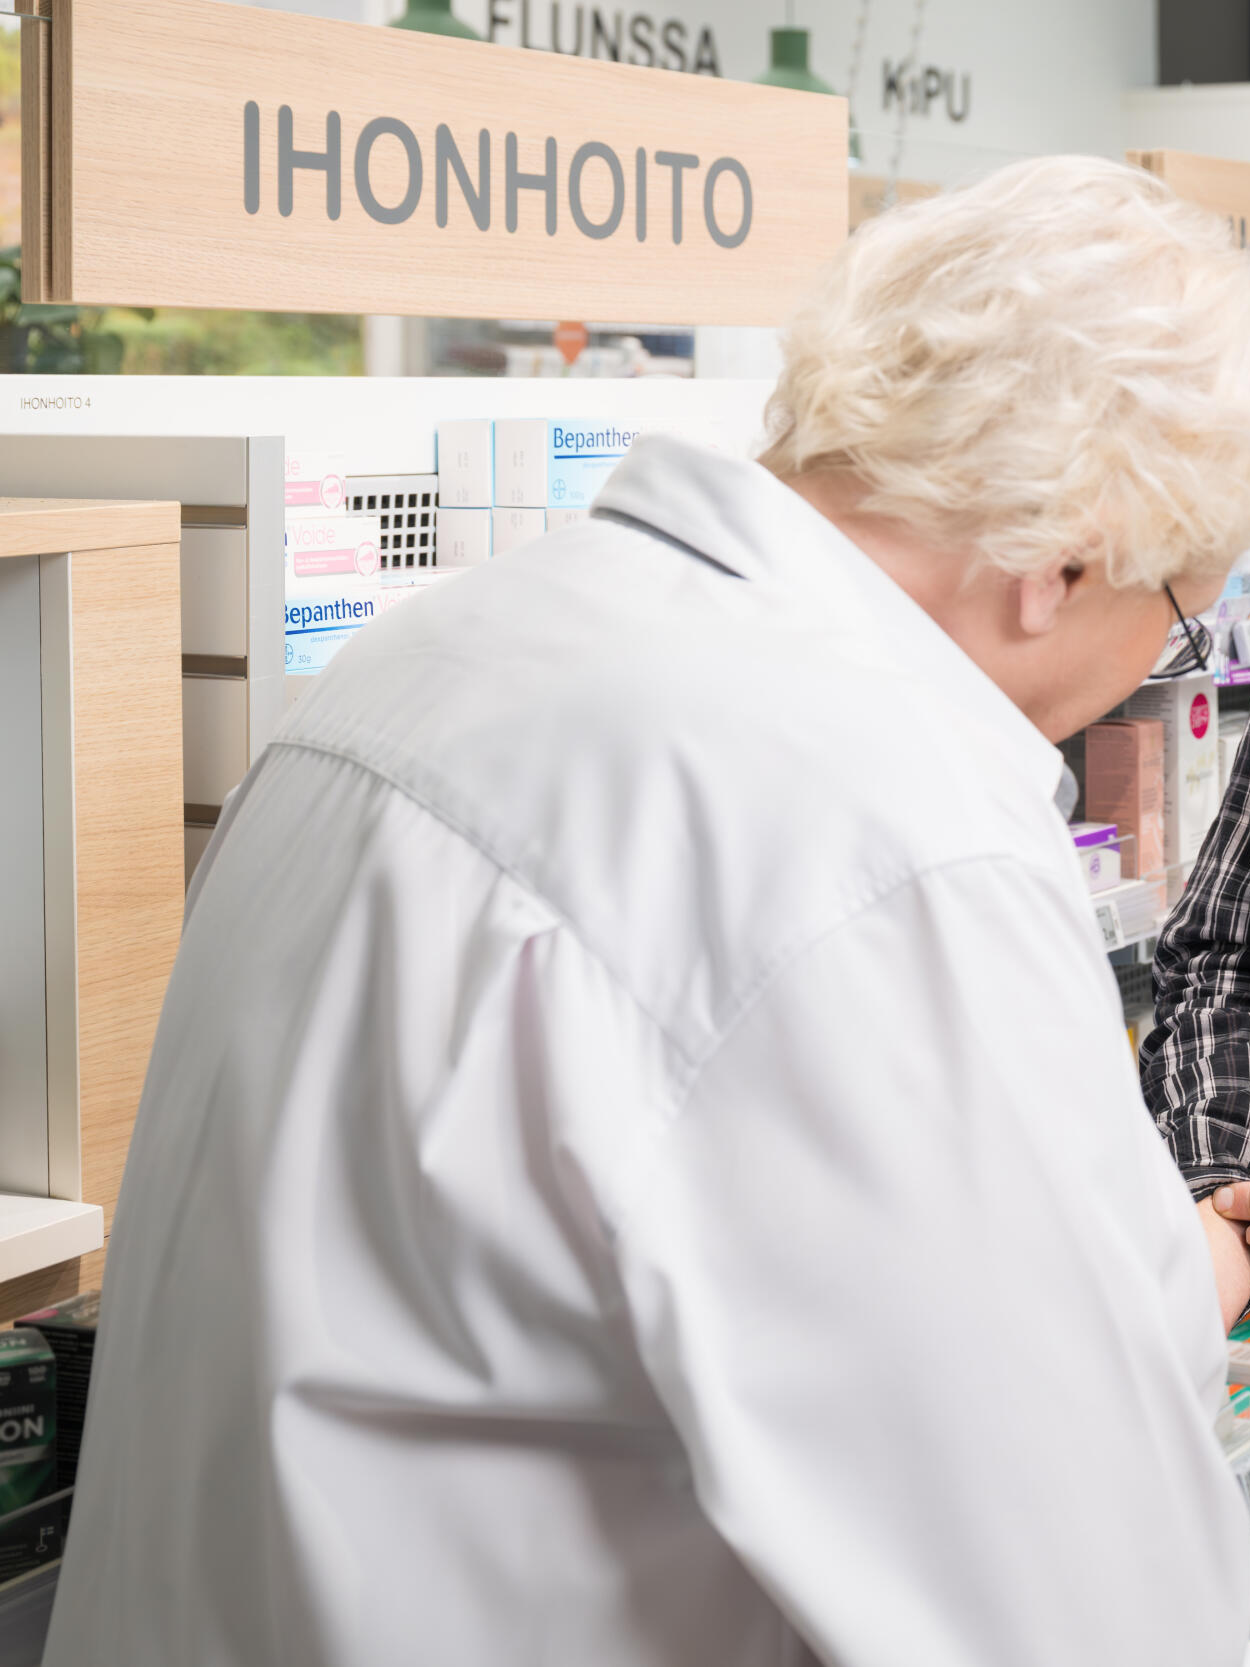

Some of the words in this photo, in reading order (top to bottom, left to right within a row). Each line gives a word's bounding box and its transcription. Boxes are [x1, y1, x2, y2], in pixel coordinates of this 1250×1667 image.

[488, 0, 723, 77] FLUNSSA
[882, 58, 972, 123] KIPU
[243, 100, 755, 250] IHONHOITO
[20, 397, 82, 409] IHONHOITO
[85, 397, 91, 408] 4
[291, 526, 335, 546] Voide
